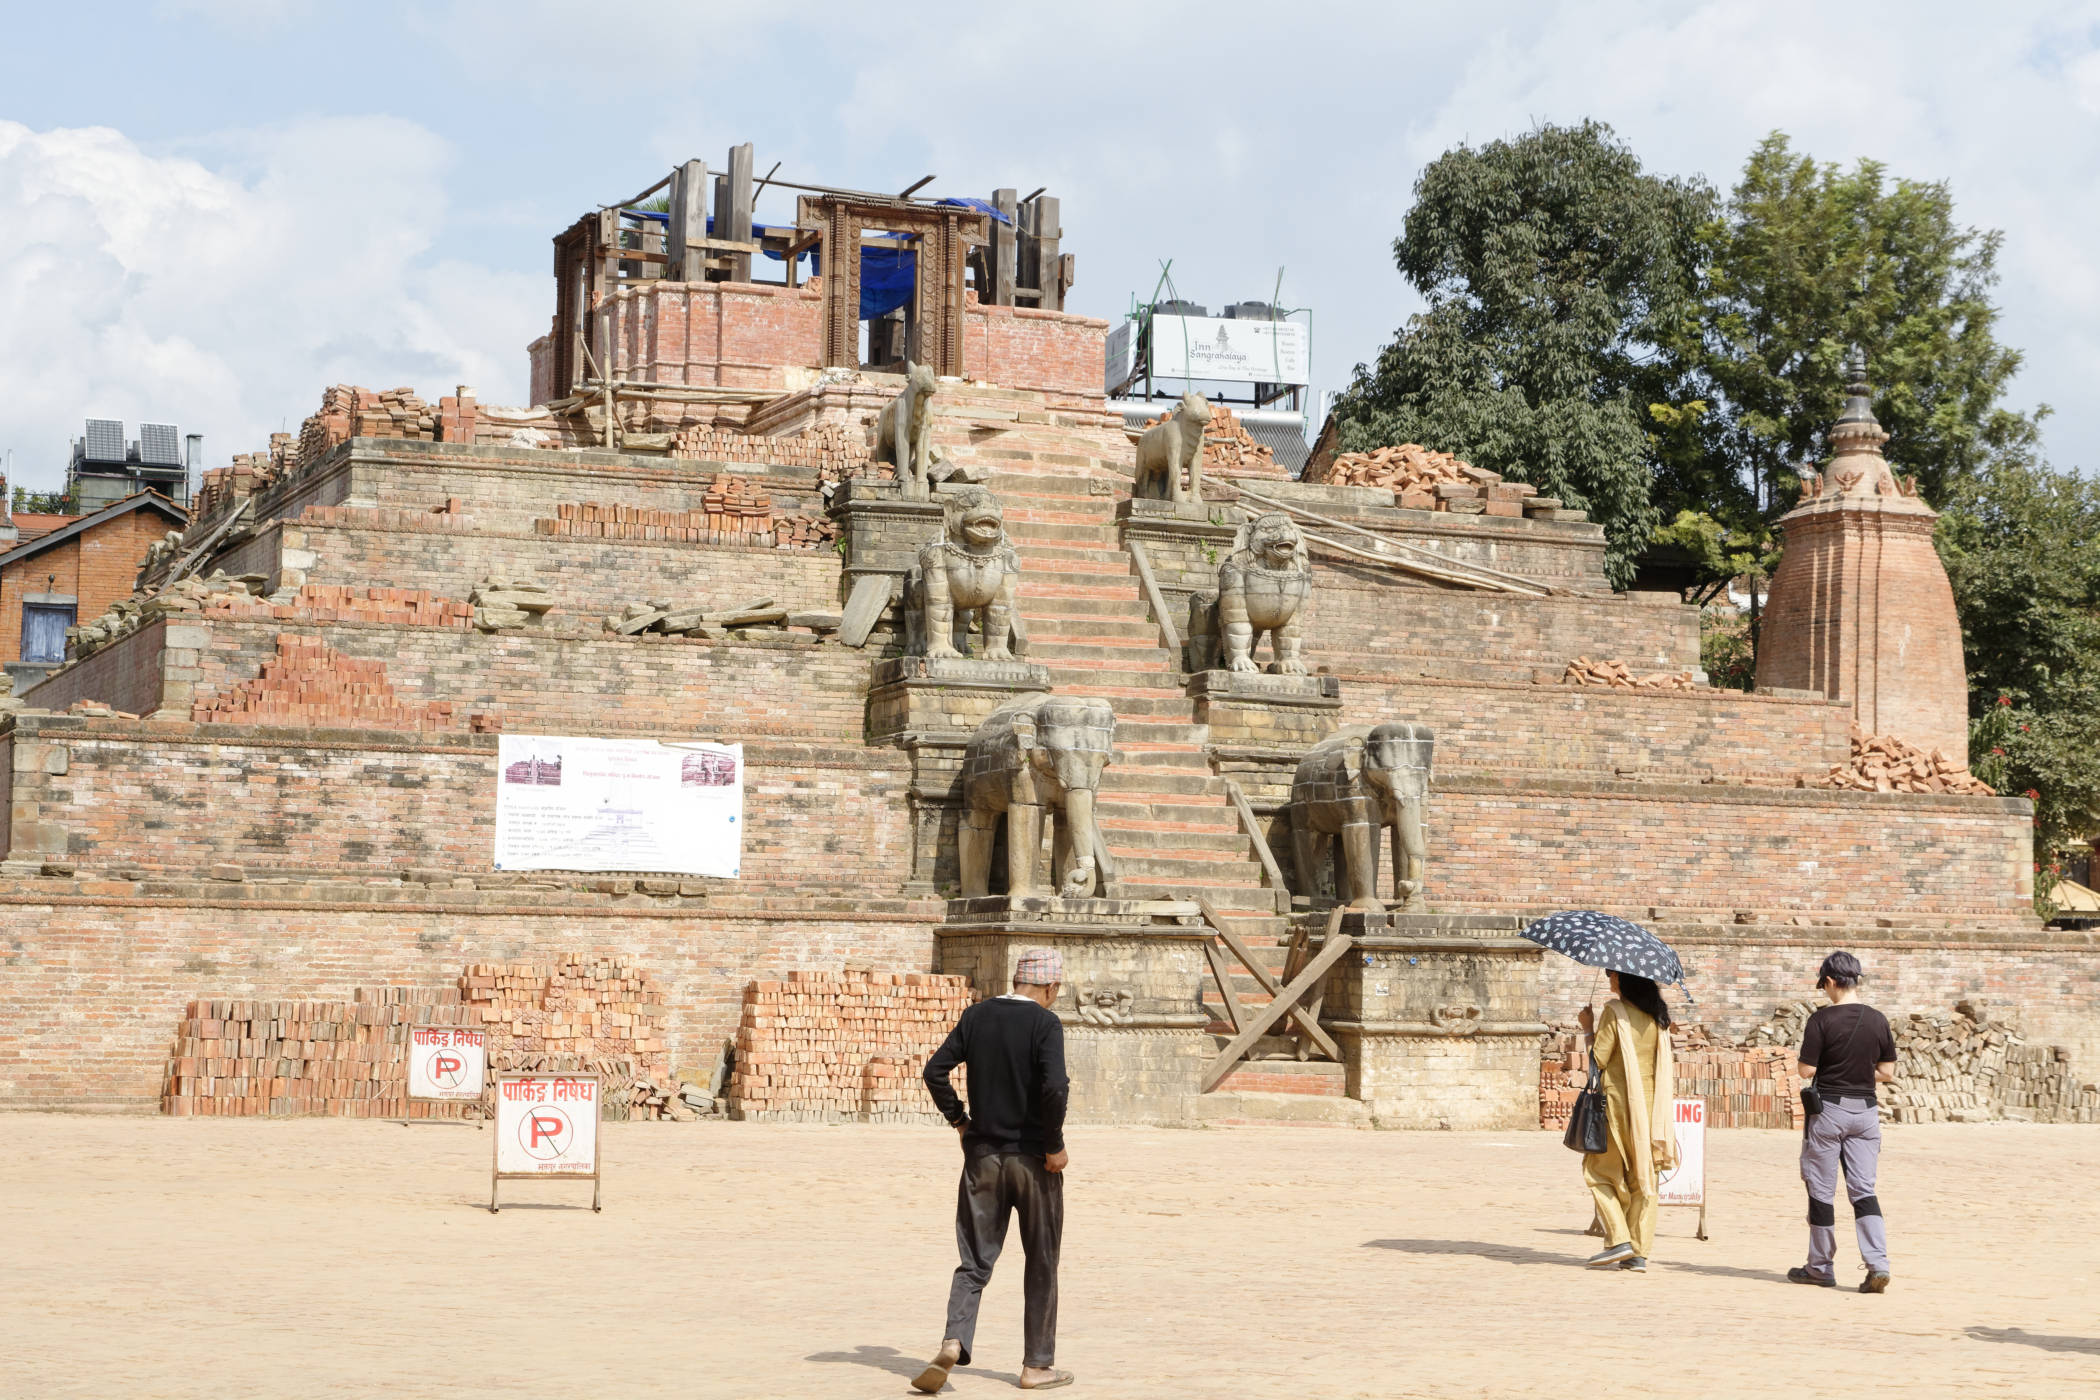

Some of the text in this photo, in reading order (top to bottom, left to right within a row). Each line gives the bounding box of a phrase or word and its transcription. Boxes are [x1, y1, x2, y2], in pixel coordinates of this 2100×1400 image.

[1194, 340, 1211, 351] Inn
[453, 1028, 483, 1047] निषेध
[435, 1057, 461, 1080] P
[552, 1077, 595, 1102] निषेध
[1676, 1103, 1701, 1122] ING
[530, 1116, 564, 1149] P
